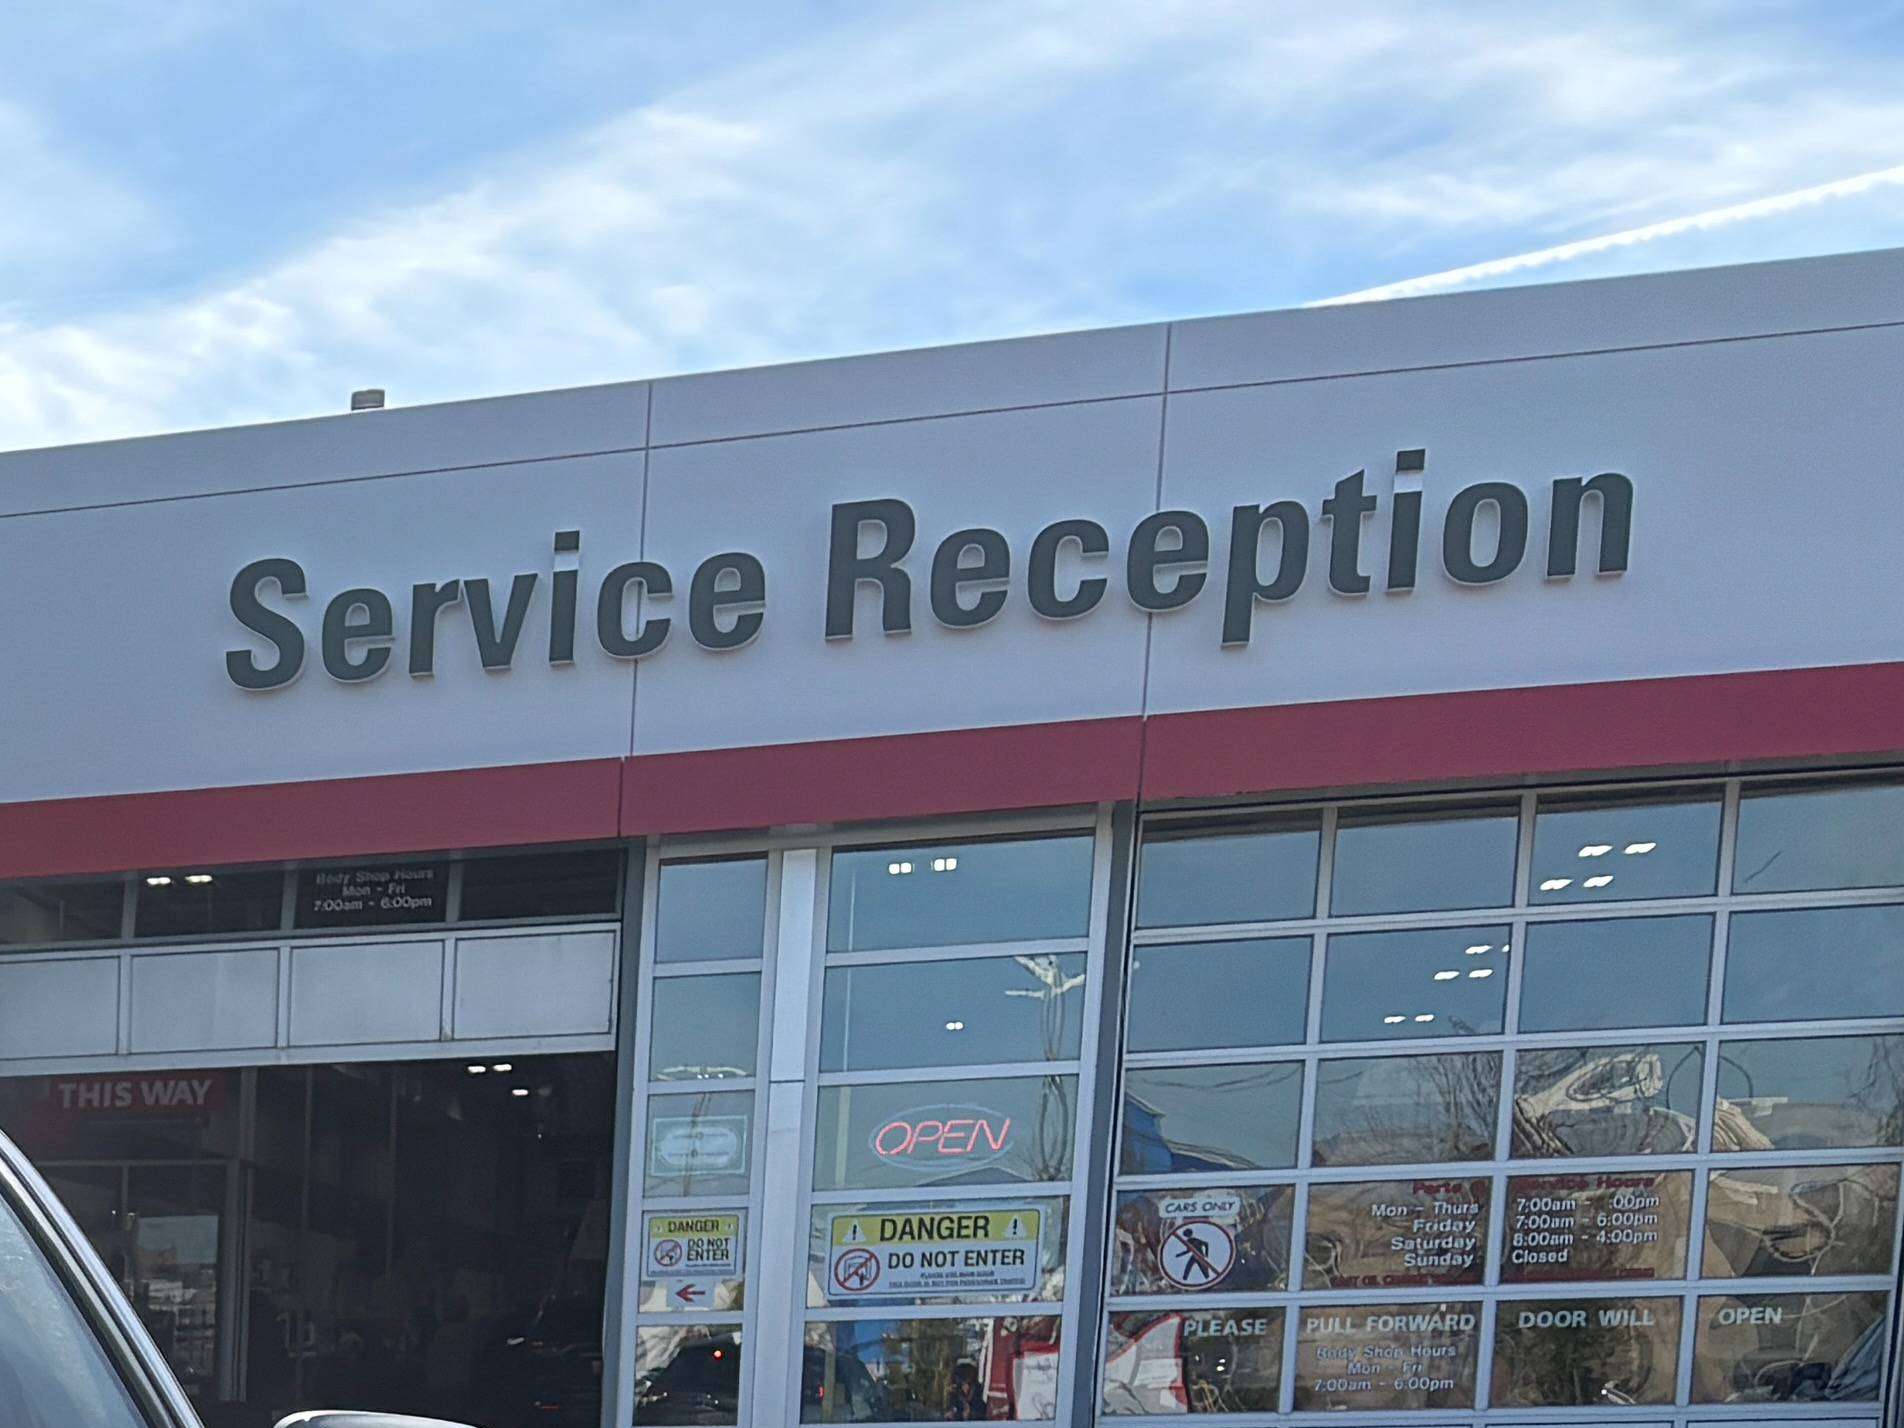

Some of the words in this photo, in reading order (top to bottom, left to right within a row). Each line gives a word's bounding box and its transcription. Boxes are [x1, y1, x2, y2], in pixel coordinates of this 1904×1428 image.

[225, 530, 767, 691] Service
[824, 448, 1634, 648] Reception
[388, 882, 405, 894] Fri
[58, 1082, 132, 1108] THIS
[142, 1079, 212, 1105] WAY
[876, 1119, 1011, 1155] OPEN
[1165, 1201, 1197, 1213] CARS
[1202, 1200, 1235, 1211] ONLY
[1371, 1204, 1406, 1217] Mon
[1433, 1202, 1479, 1215] Thurs
[1517, 1198, 1576, 1212] 7:00am
[1603, 1195, 1660, 1209] :00pm
[667, 1220, 719, 1233] DANGER
[880, 1215, 990, 1241] DANGER
[1412, 1219, 1476, 1233] Friday
[1516, 1215, 1574, 1229] 7:00am
[1597, 1212, 1658, 1227] 6:00pm
[688, 1238, 704, 1249] DO
[707, 1237, 730, 1249] NOT
[1392, 1235, 1476, 1250] Saturday
[1596, 1229, 1658, 1244] 4:00pm
[686, 1249, 729, 1261] ENTER
[888, 1252, 914, 1269] DO
[921, 1251, 960, 1268] NOT
[964, 1249, 1025, 1267] ENTER
[1404, 1253, 1474, 1267] Sunday
[1512, 1249, 1568, 1263] Closed
[1184, 1318, 1267, 1337] PLEASE
[1306, 1315, 1356, 1333] PULL
[1366, 1314, 1476, 1332] FORWARD
[1518, 1311, 1586, 1328] DOOR
[1598, 1309, 1655, 1327] WILL
[1718, 1307, 1782, 1325] OPEN
[1363, 1345, 1403, 1358] Shop
[1410, 1344, 1457, 1357] Hours
[1347, 1362, 1380, 1375] Mon
